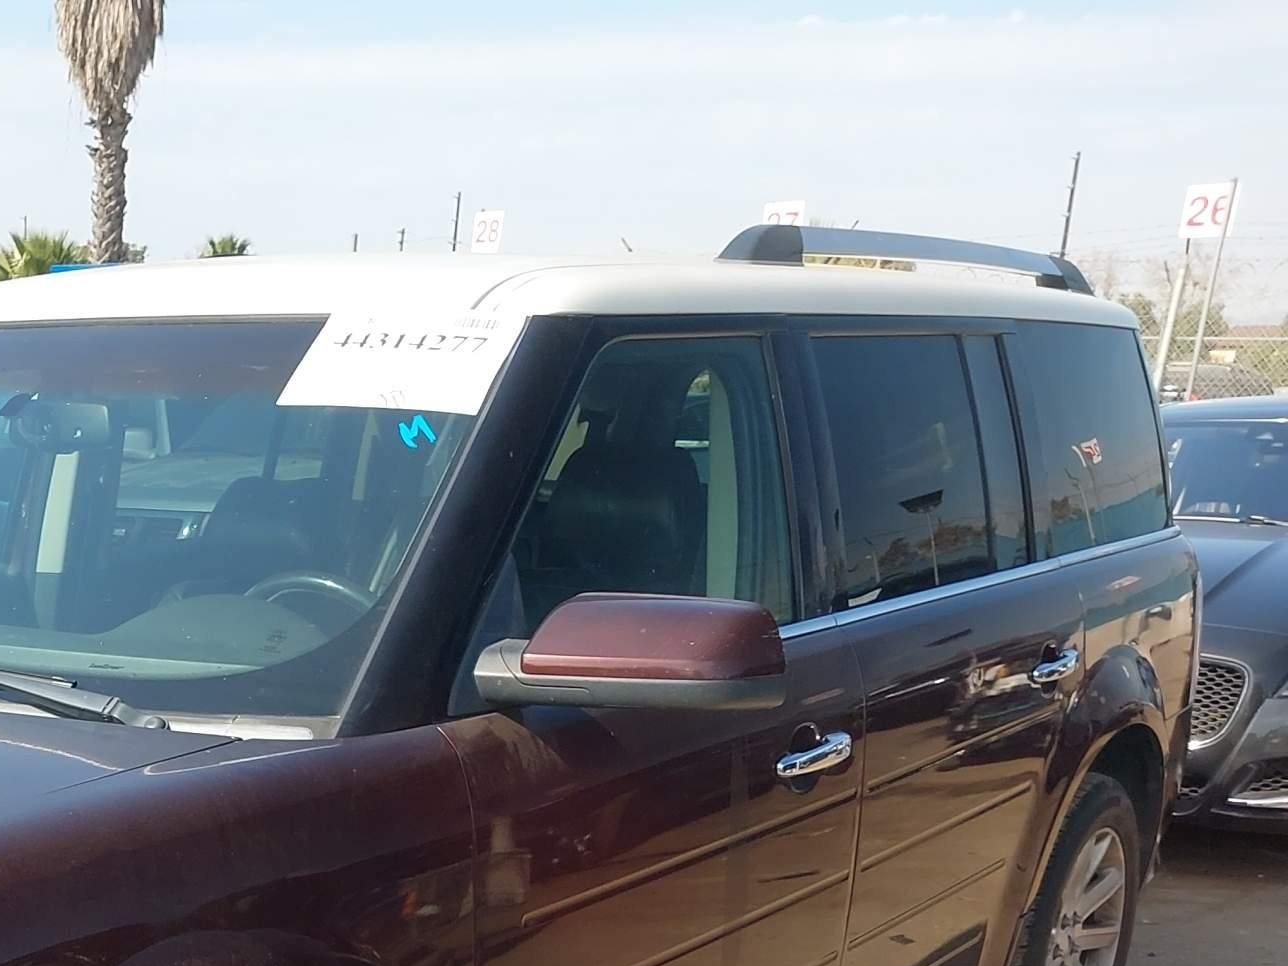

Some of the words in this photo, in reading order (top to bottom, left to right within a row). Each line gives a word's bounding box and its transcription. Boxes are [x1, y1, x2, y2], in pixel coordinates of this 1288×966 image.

[1186, 195, 1230, 226] 26
[476, 220, 500, 243] 28
[333, 332, 489, 352] 44314277
